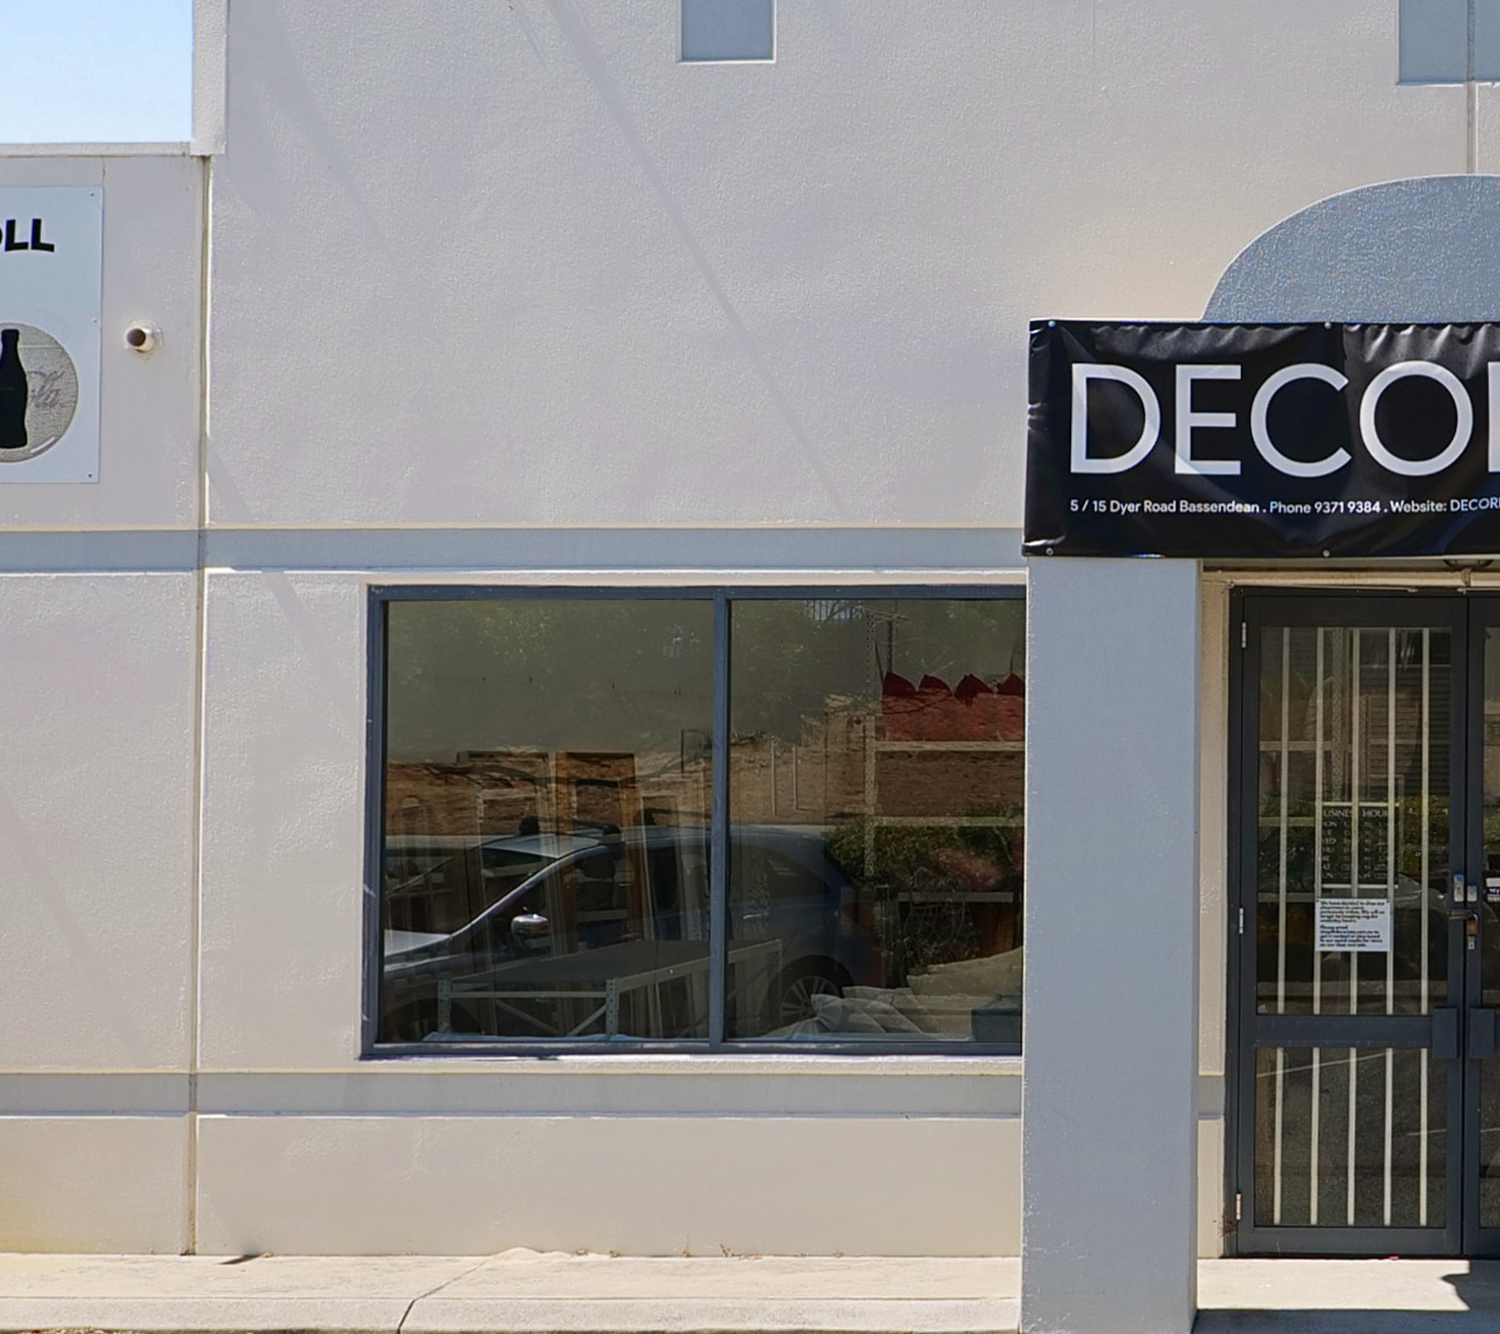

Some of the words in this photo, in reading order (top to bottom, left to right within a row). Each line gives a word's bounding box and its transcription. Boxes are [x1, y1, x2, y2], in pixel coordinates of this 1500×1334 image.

[1070, 499, 1079, 512] 5
[1092, 500, 1107, 512] 15
[1110, 500, 1141, 515] Dyer
[1144, 500, 1176, 513] Road
[1180, 500, 1260, 513] Bassendean
[1270, 501, 1311, 514] Phone
[1314, 501, 1345, 513] 9371
[1348, 500, 1381, 513] 9384
[1390, 499, 1448, 513] Website:
